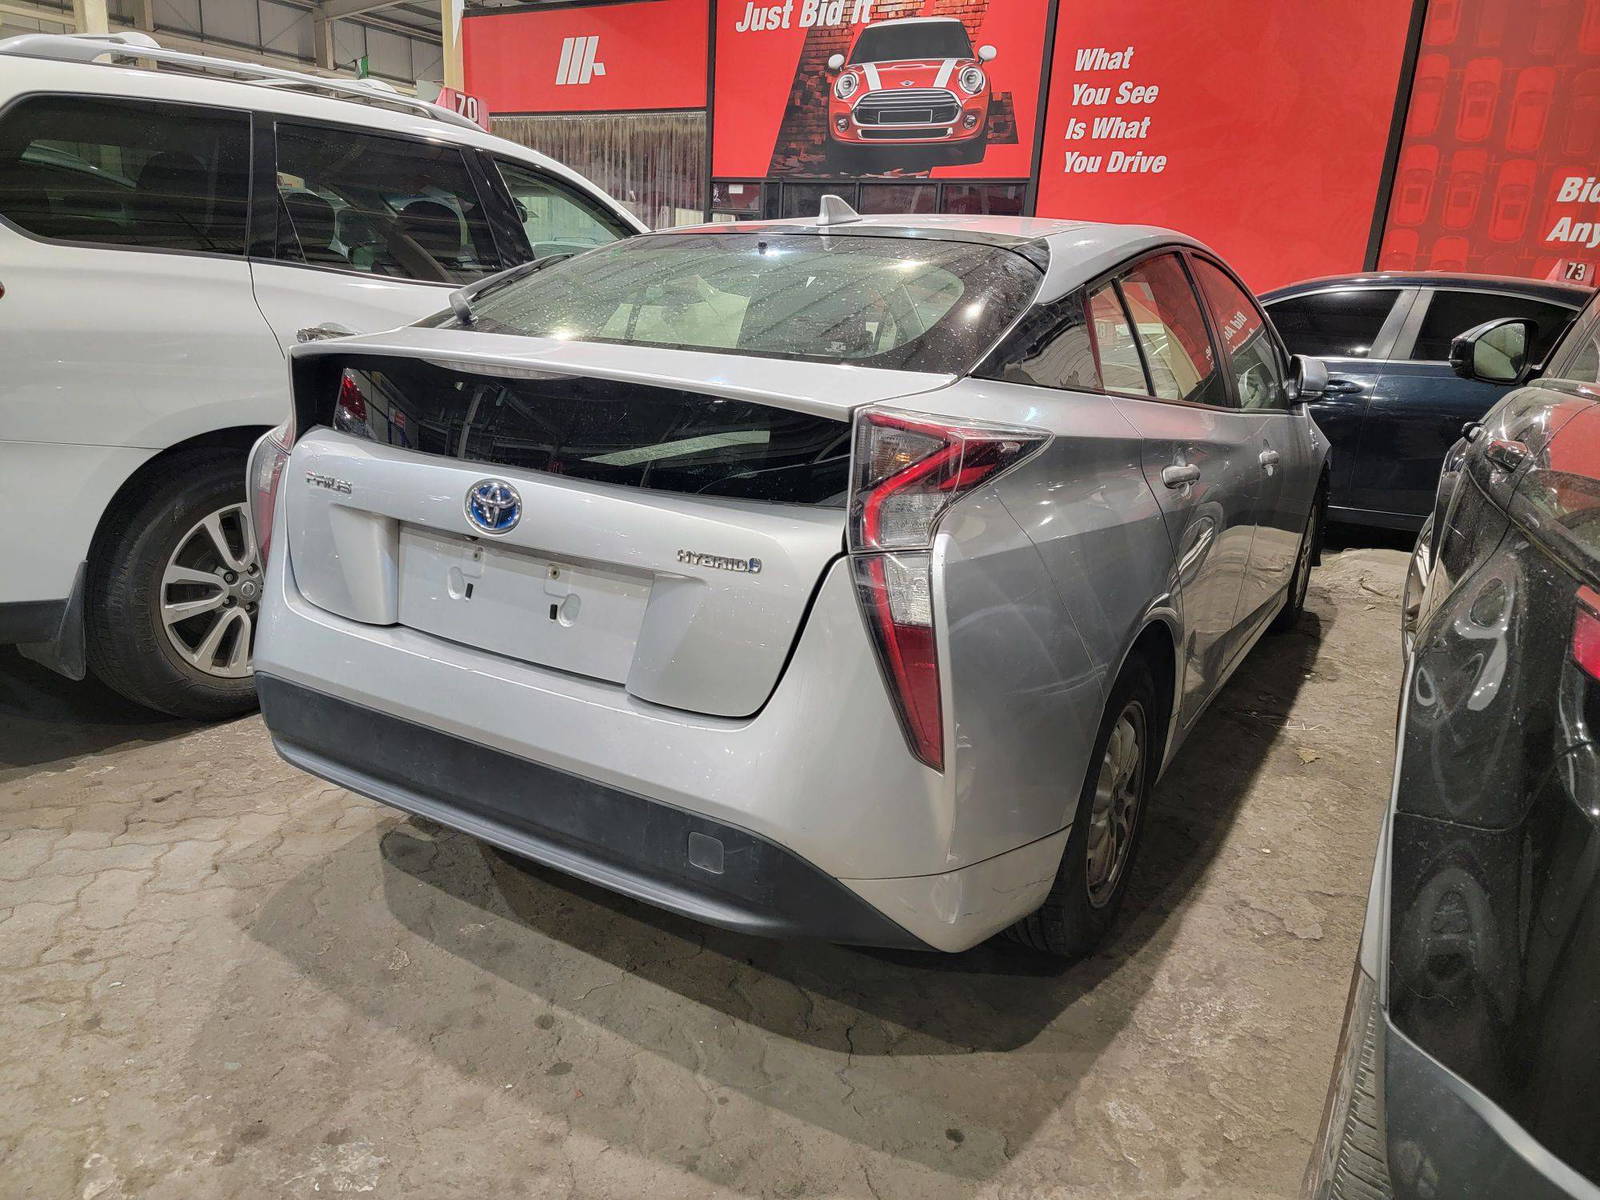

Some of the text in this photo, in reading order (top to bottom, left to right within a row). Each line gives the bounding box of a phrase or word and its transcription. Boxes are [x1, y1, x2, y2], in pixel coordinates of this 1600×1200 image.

[735, 0, 872, 32] Just Bid It
[1074, 46, 1134, 71] What
[1072, 81, 1159, 106] You See
[456, 93, 478, 122] 70
[1065, 116, 1151, 139] Is What
[1064, 151, 1167, 173] You Drive
[1565, 262, 1586, 281] 73
[677, 549, 748, 573] HYBRID
